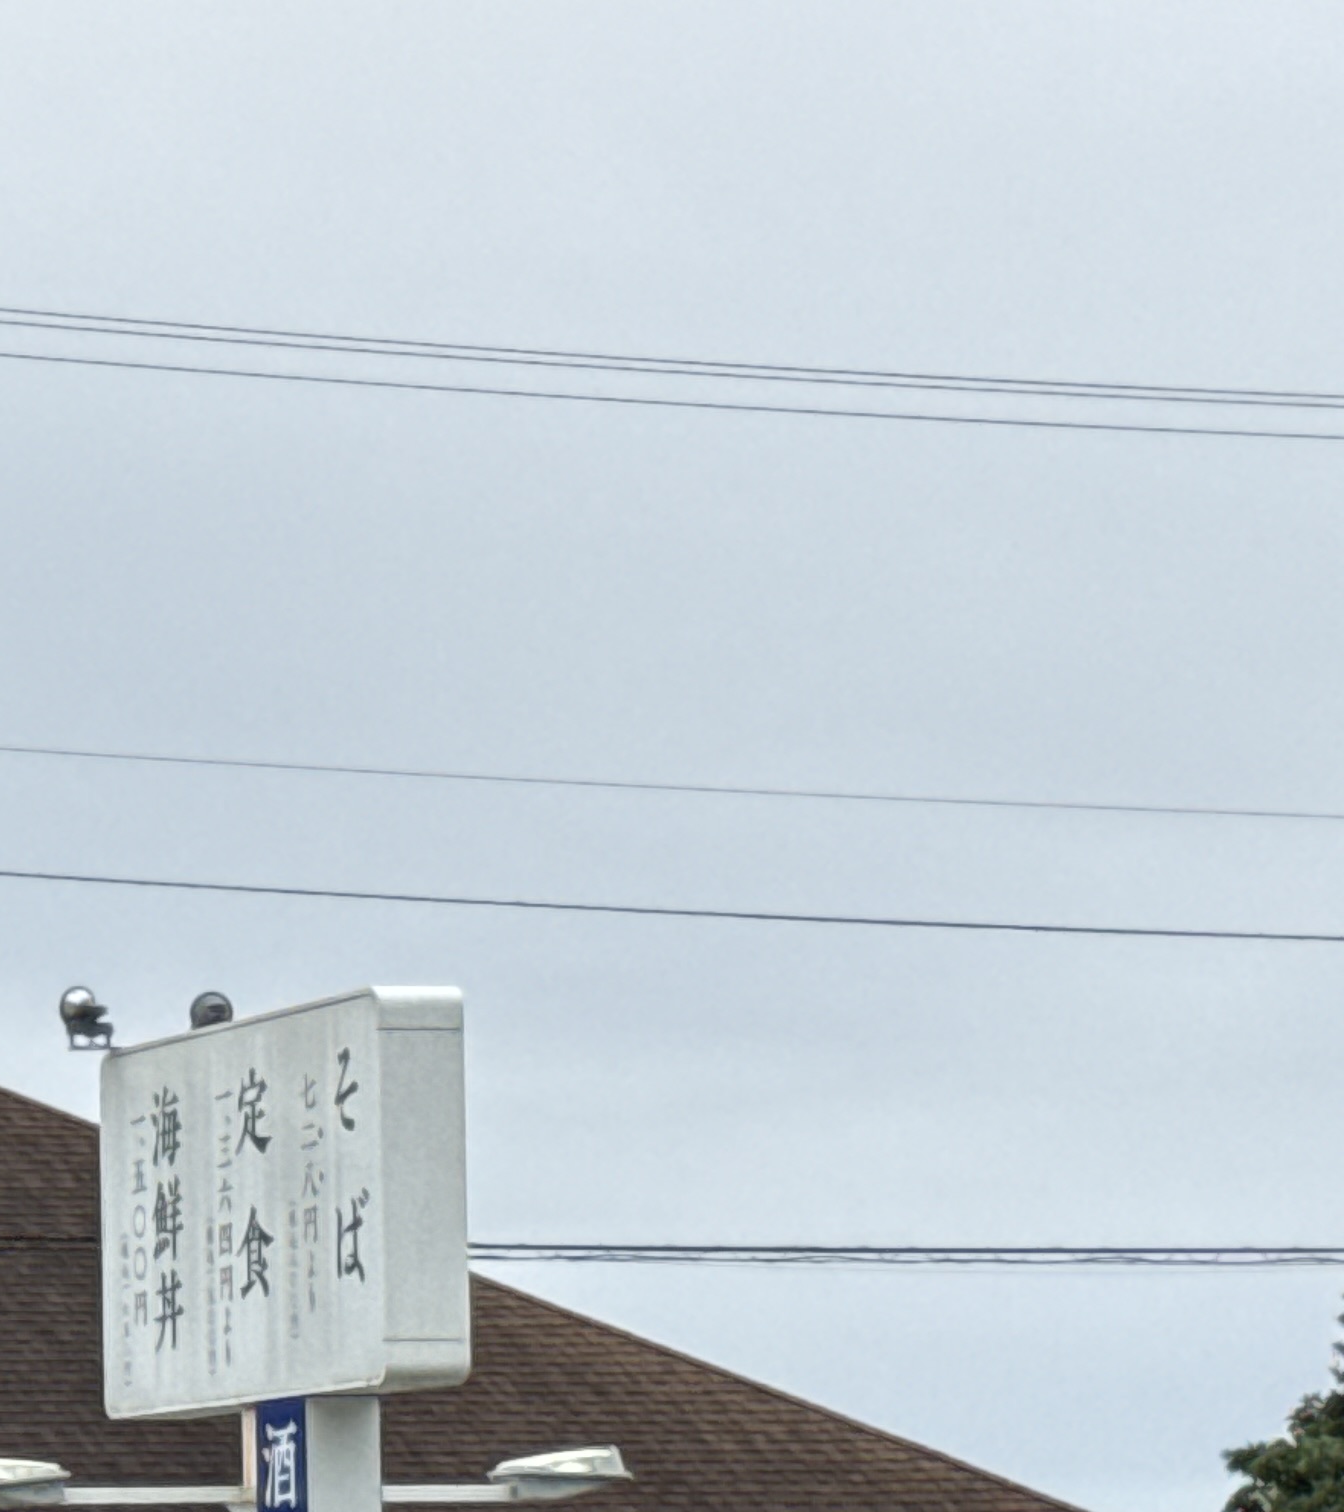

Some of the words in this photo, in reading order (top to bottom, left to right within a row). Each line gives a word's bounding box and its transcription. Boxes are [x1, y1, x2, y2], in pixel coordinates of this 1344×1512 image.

[151, 1086, 184, 1355] 海鮮丼
[234, 1066, 275, 1300] 定食
[334, 1047, 370, 1283] そば
[262, 1417, 298, 1510] 酒
